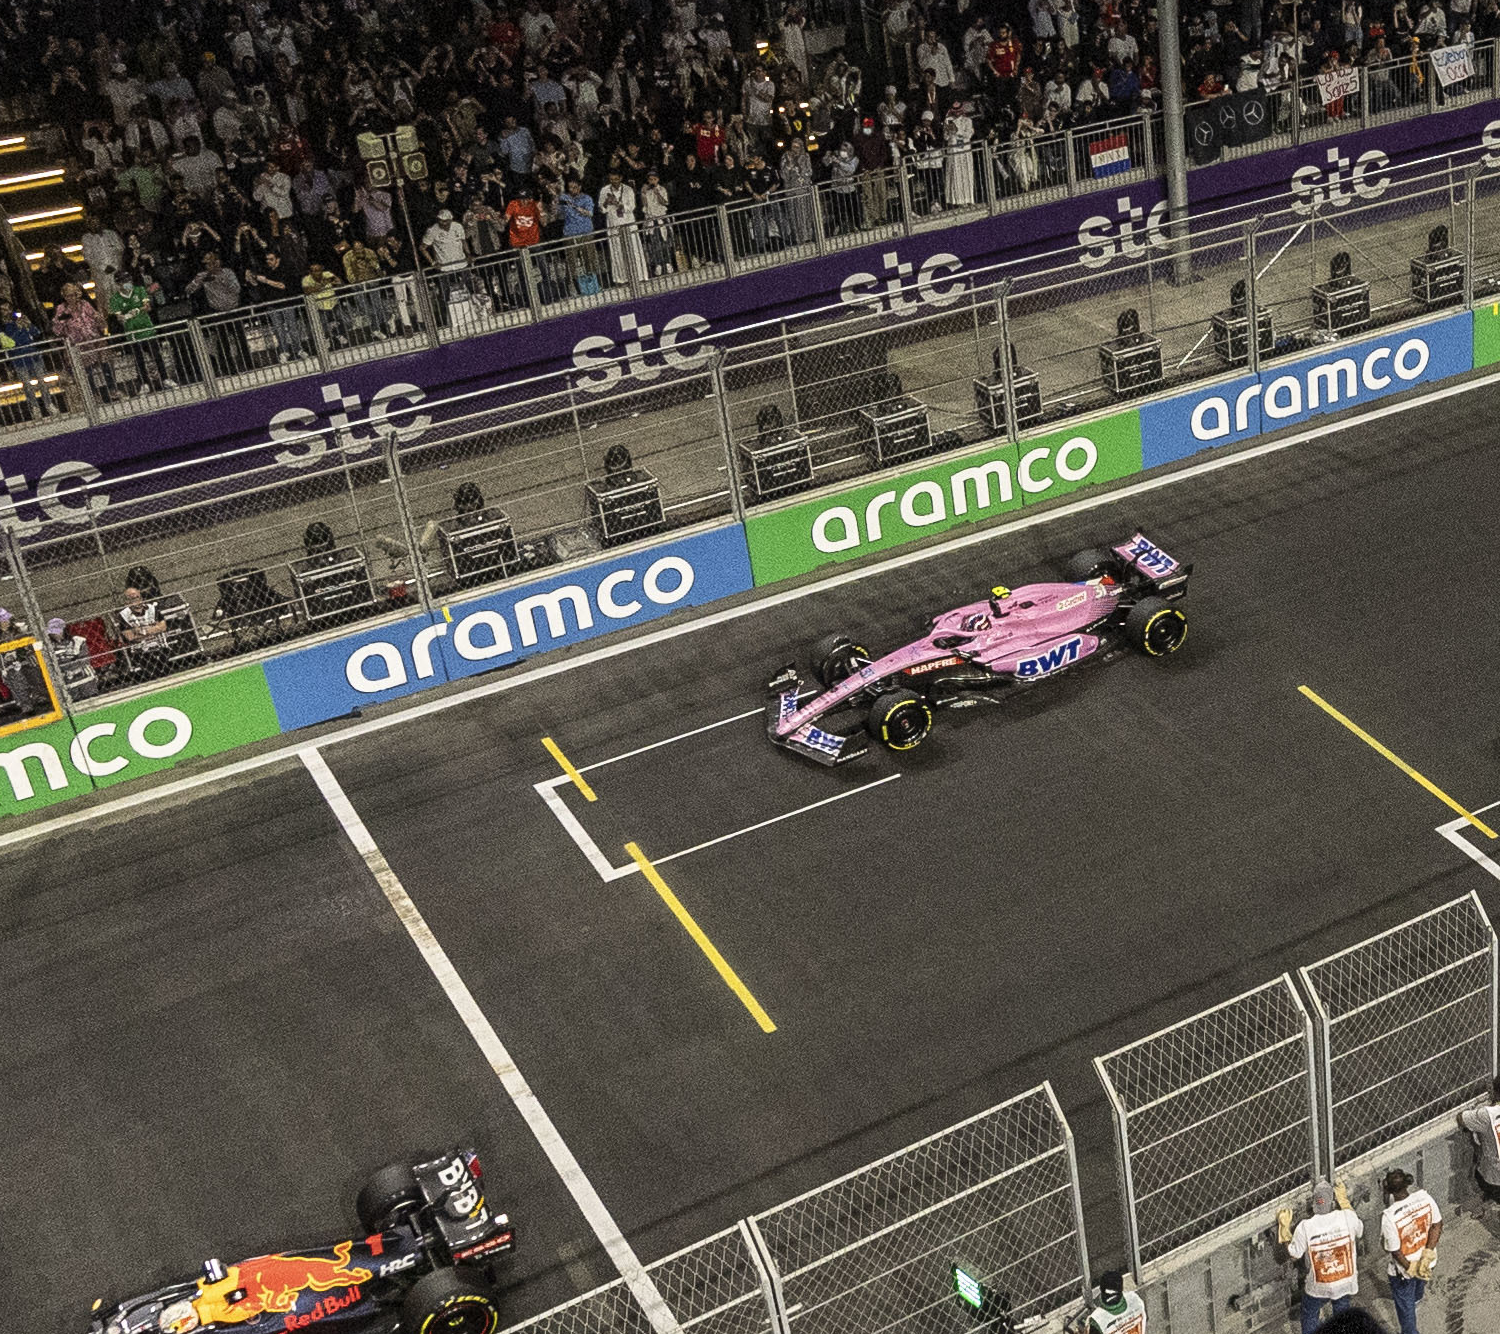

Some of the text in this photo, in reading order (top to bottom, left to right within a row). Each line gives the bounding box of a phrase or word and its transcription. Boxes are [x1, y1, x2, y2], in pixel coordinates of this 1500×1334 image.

[1291, 147, 1392, 216] stc
[1077, 195, 1188, 271] stc
[841, 251, 966, 316] stc
[571, 313, 716, 393] stc
[1191, 337, 1430, 441] aramco
[268, 381, 432, 467] stc
[812, 436, 1097, 553] aramco
[345, 556, 695, 693] aramco
[1017, 638, 1084, 678] BWT
[910, 657, 957, 676] MAPFRE
[365, 1233, 384, 1256] 1
[380, 1253, 416, 1277] HRC
[283, 1285, 362, 1333] Red Bull
